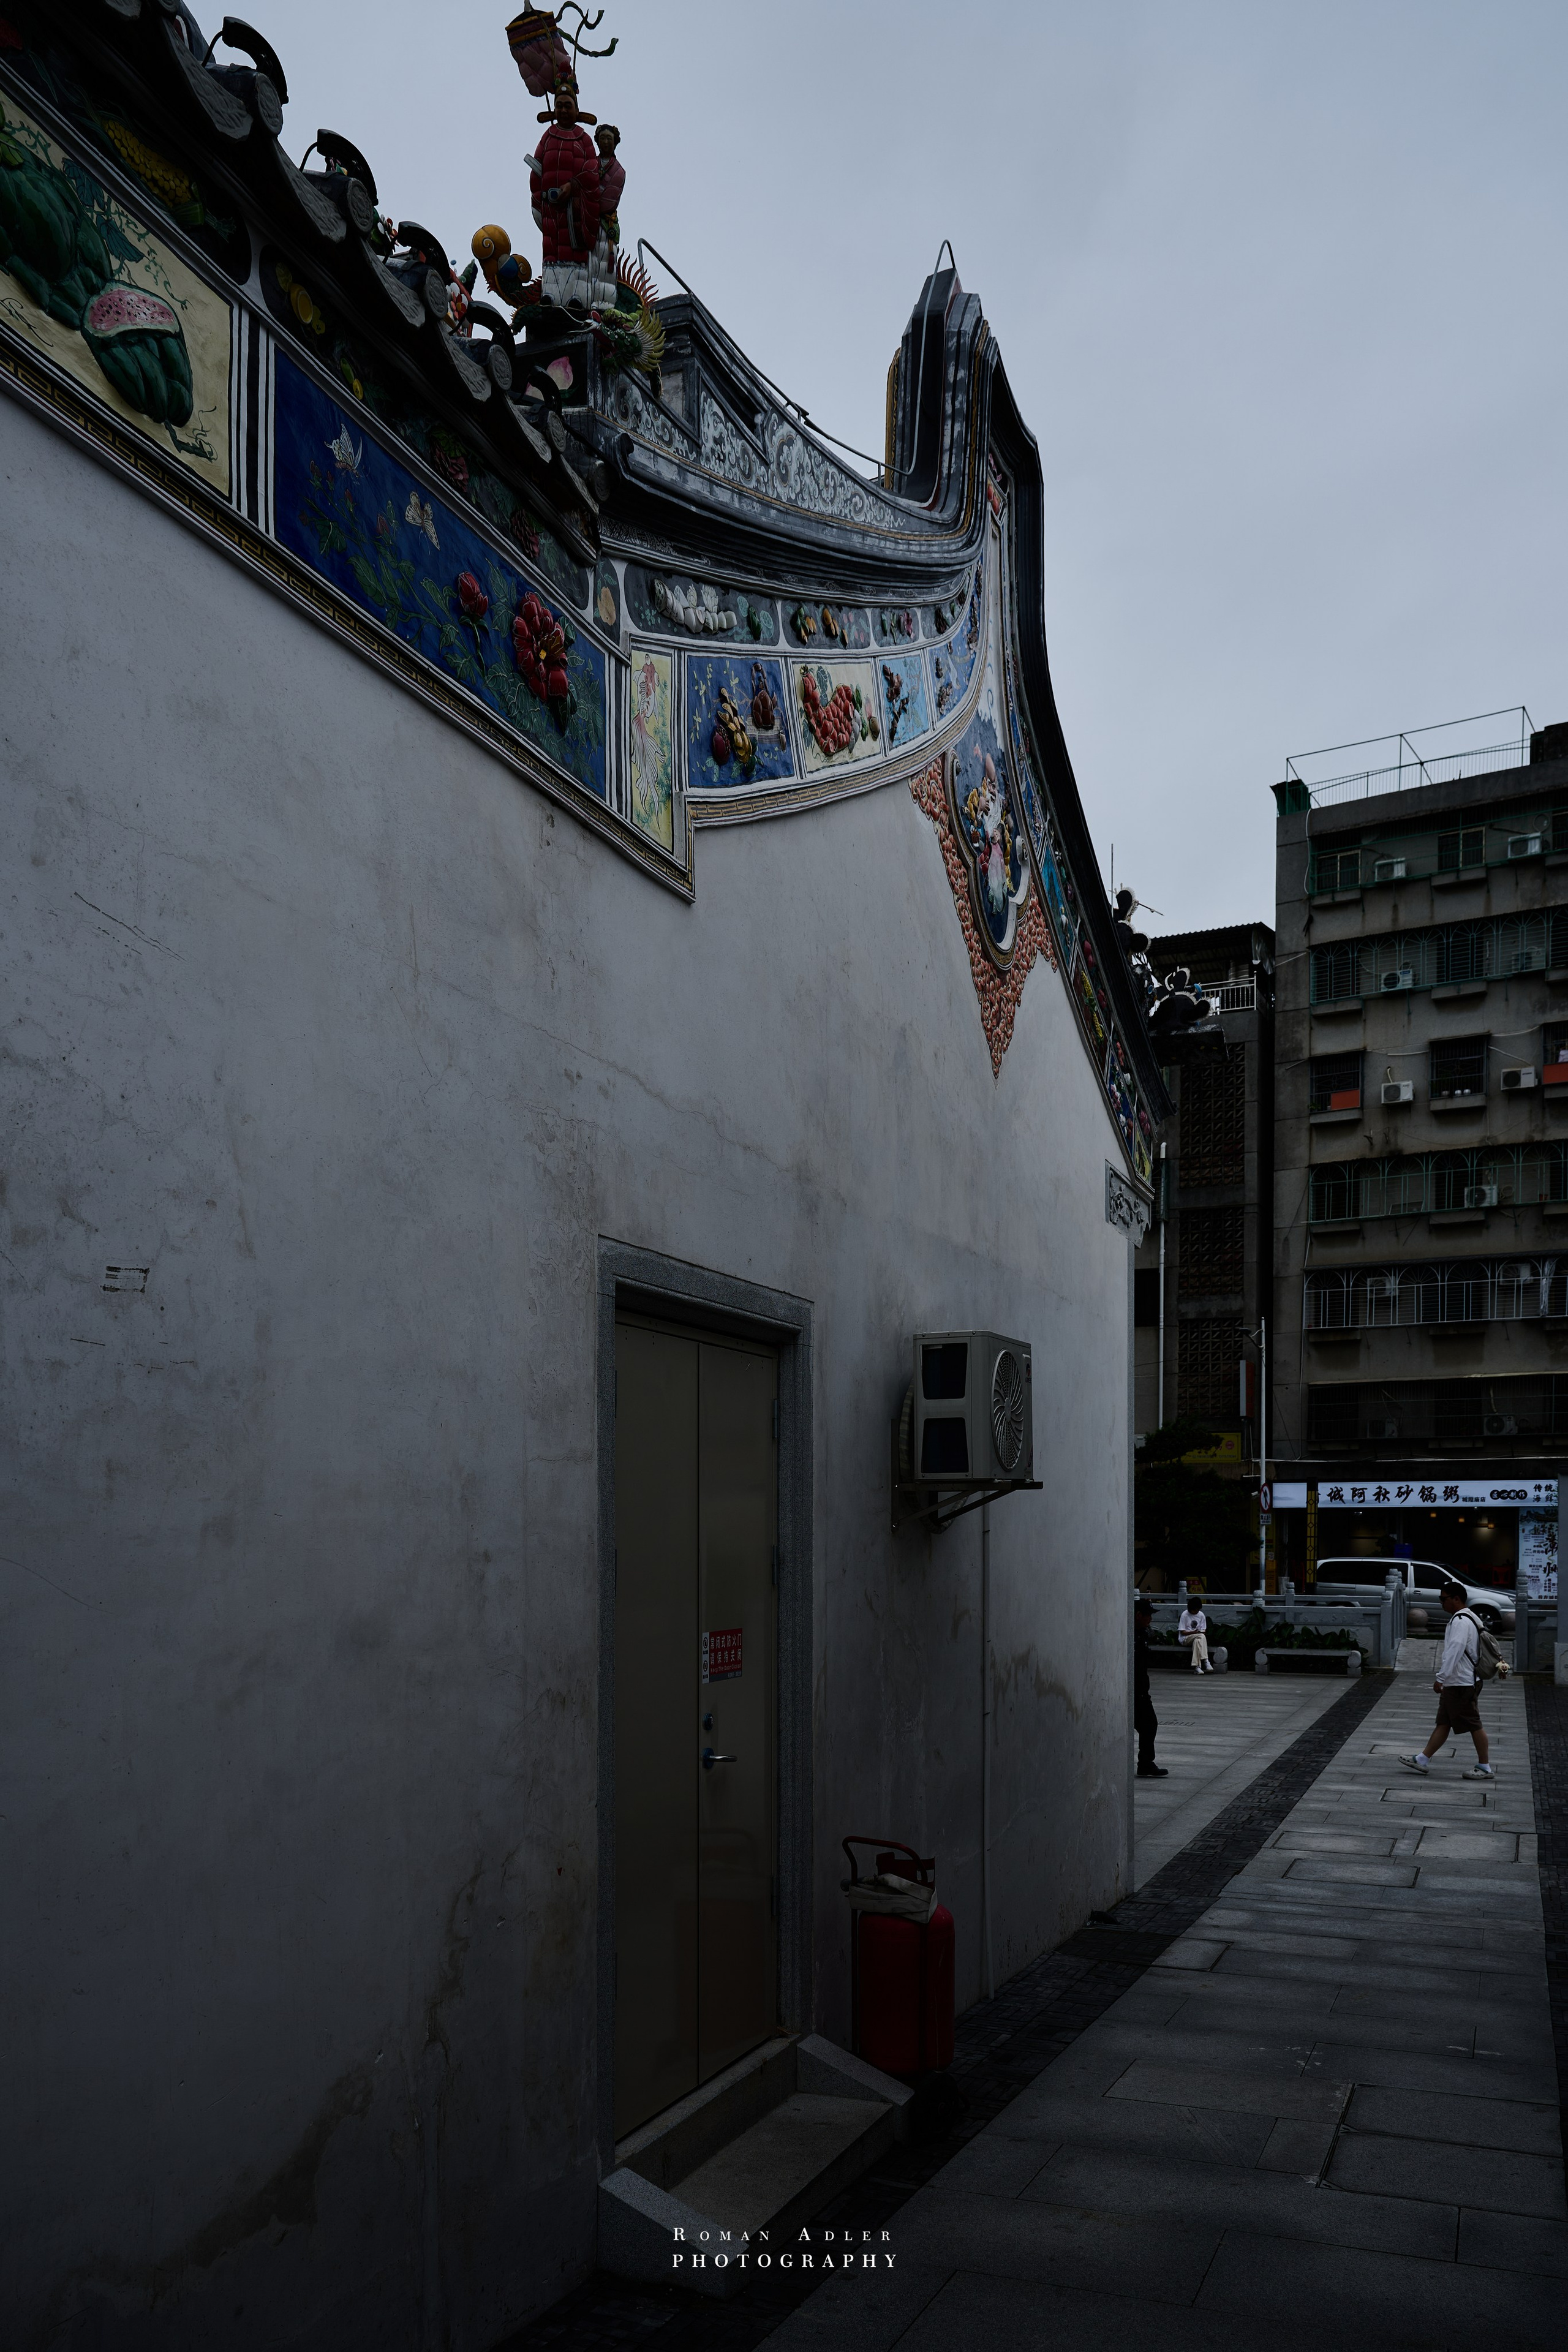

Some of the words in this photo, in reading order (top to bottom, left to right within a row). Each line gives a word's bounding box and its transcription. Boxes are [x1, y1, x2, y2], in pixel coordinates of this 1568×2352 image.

[1305, 1485, 1460, 1504] 城阿秋砂锅粥
[1532, 1483, 1553, 1493] 传统
[1532, 1494, 1553, 1502] 海鲜
[710, 1634, 742, 1649] 常闭式防火门
[710, 1648, 742, 1665] 请保持关闭
